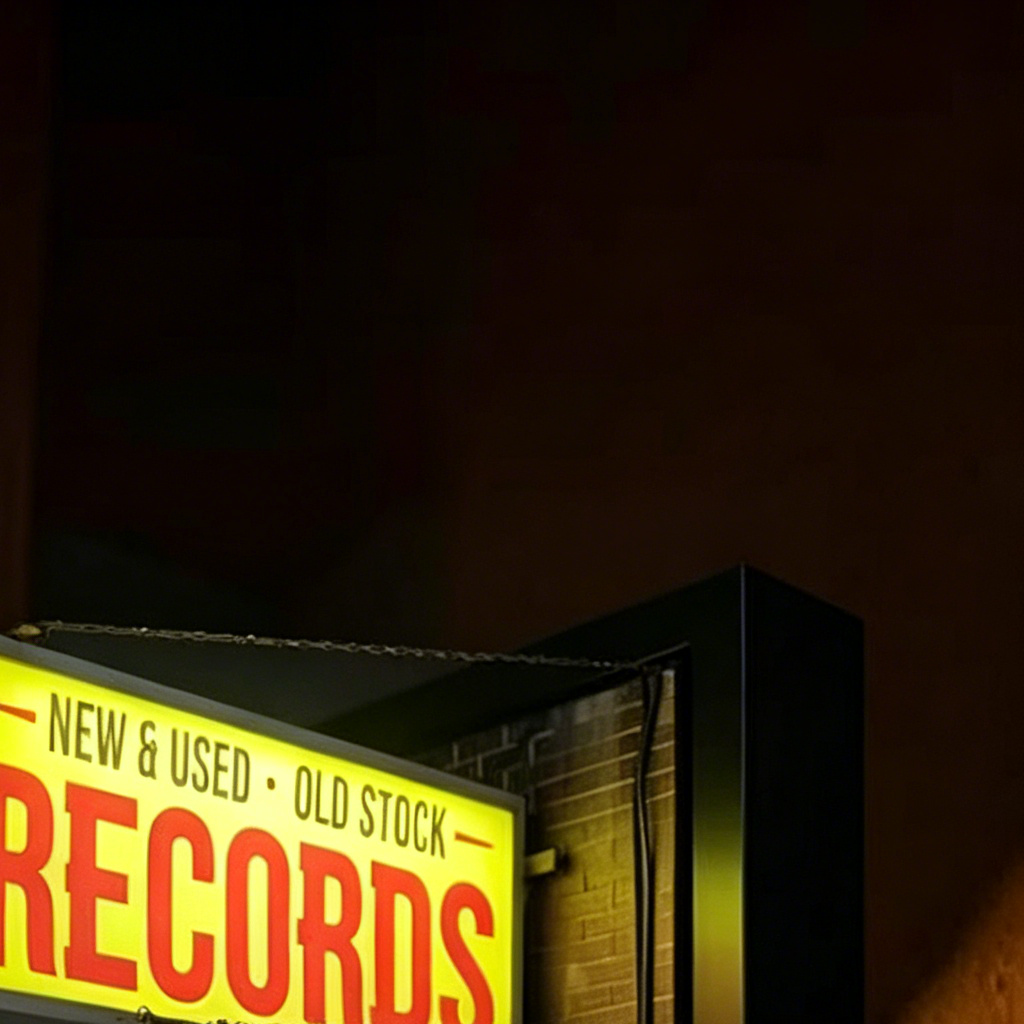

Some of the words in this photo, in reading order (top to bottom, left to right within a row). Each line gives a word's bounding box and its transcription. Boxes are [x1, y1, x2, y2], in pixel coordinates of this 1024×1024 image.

[49, 693, 126, 770] NEW
[138, 720, 156, 779] &
[170, 728, 250, 803] USED
[294, 765, 349, 830] OLD
[359, 784, 446, 859] STOCK
